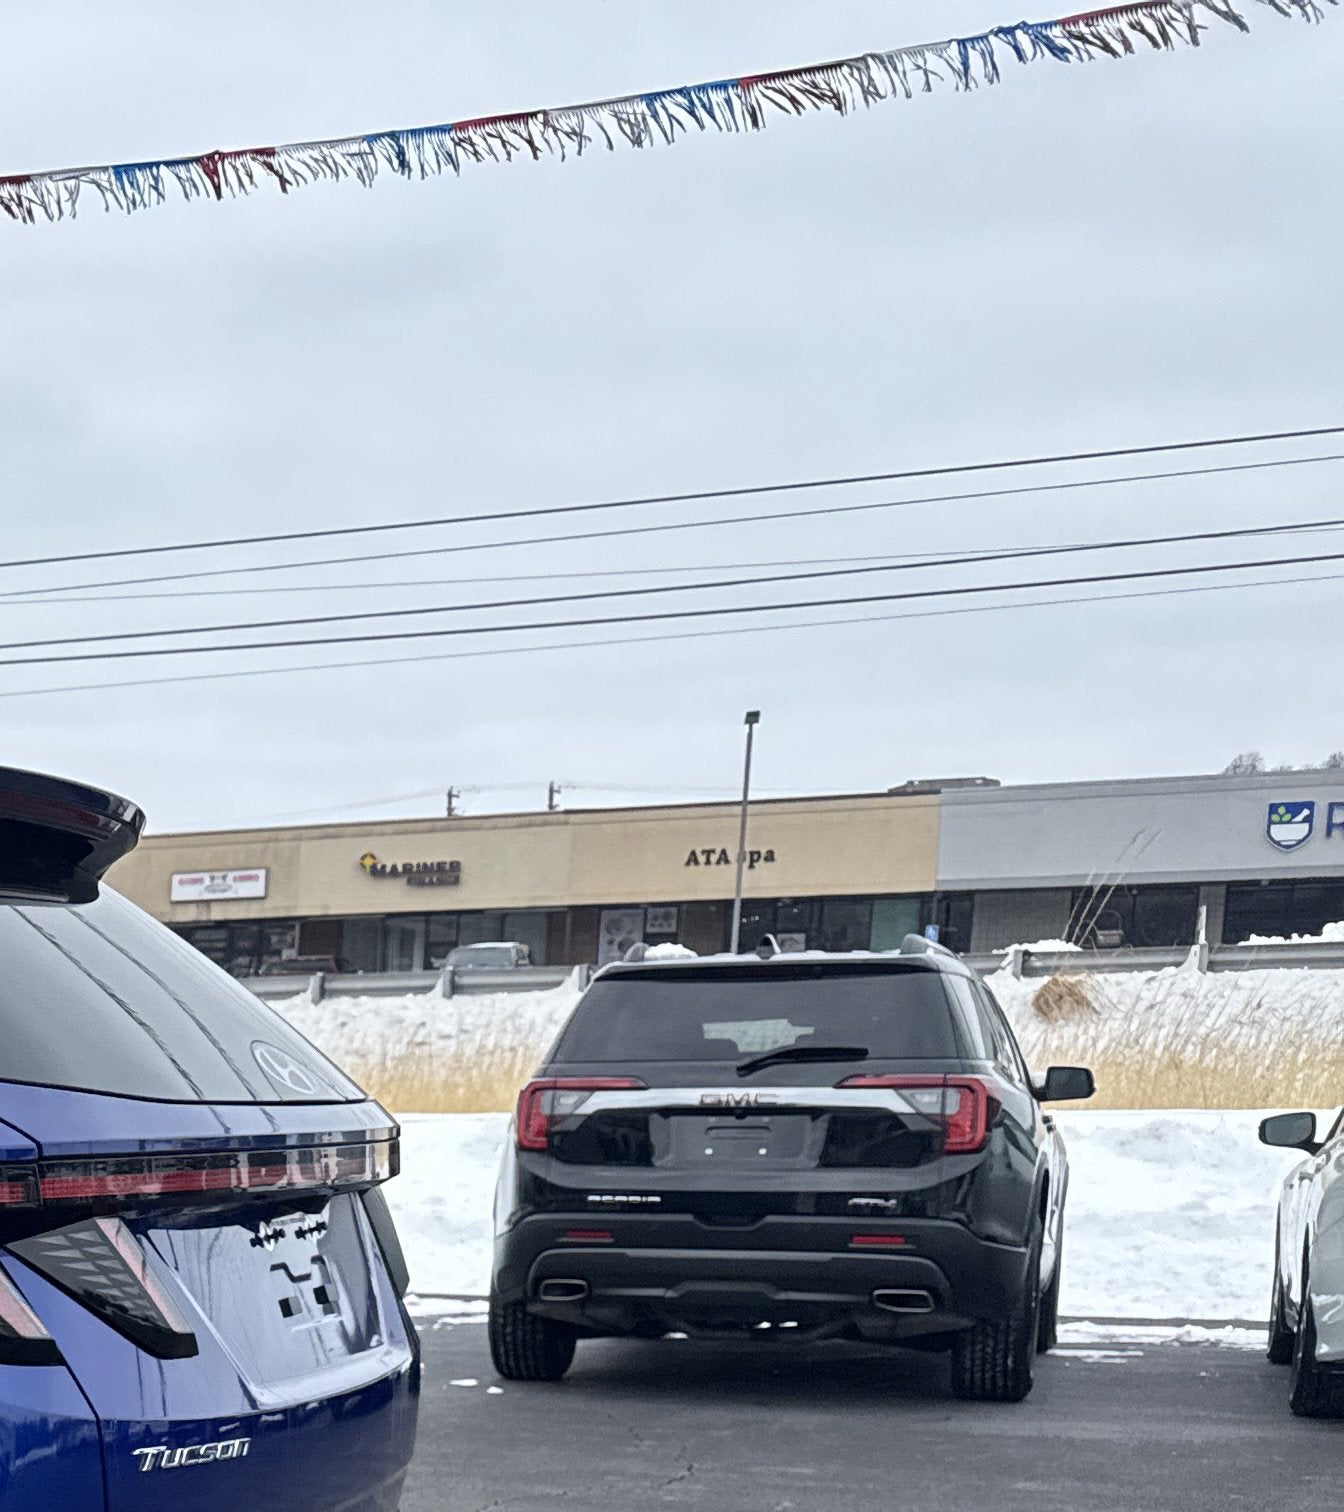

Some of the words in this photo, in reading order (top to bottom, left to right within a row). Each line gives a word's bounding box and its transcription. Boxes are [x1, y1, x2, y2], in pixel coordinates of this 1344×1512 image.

[685, 848, 731, 866] ATA
[737, 849, 775, 869] pa
[699, 1092, 779, 1108] GMC
